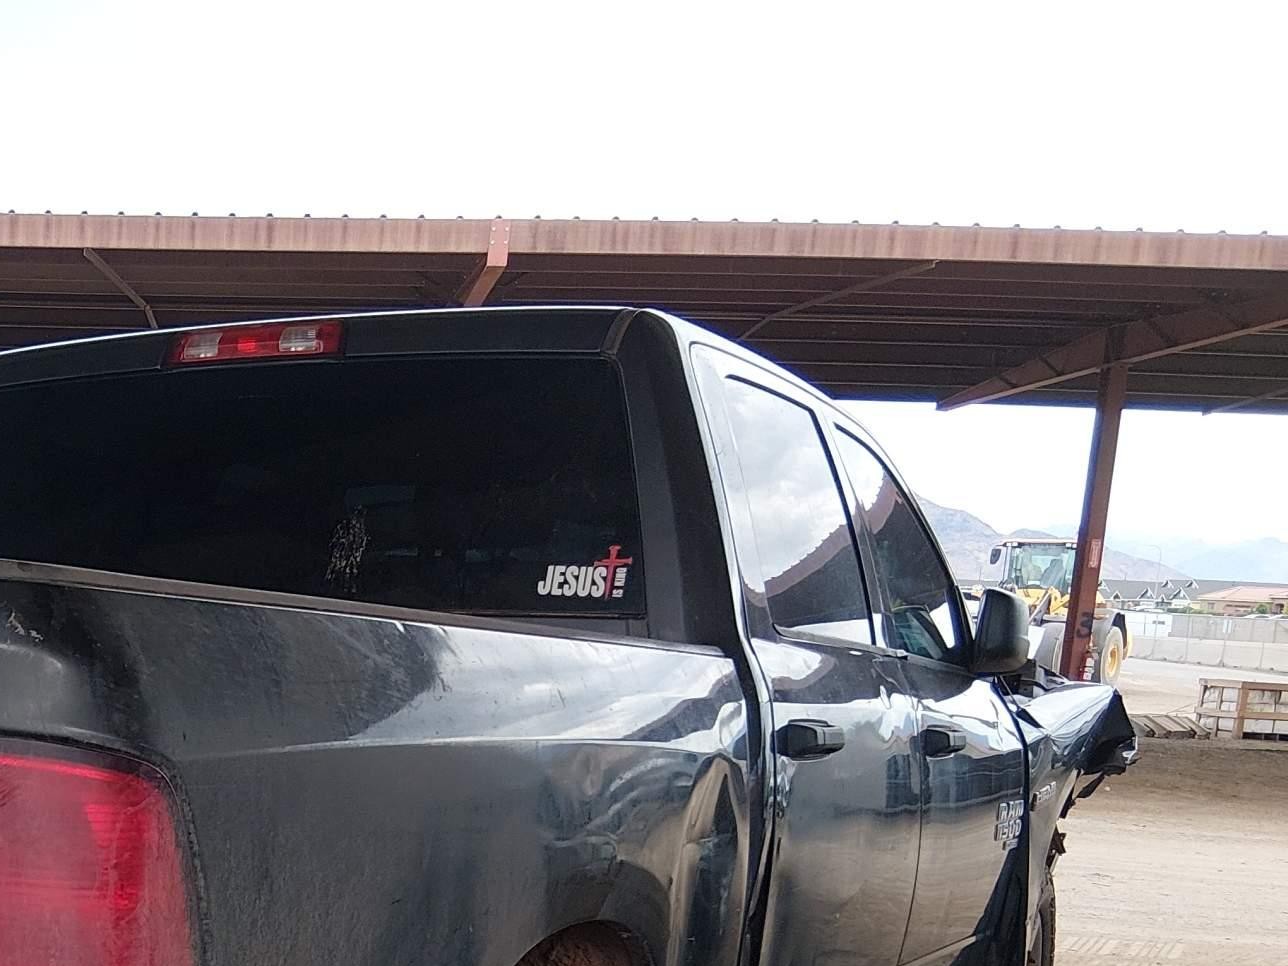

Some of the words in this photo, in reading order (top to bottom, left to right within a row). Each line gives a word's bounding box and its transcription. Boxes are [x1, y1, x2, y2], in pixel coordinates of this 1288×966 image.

[537, 565, 607, 598] JESUS
[614, 567, 628, 587] KING
[612, 589, 624, 598] IS
[998, 800, 1024, 821] RAM
[994, 819, 1022, 841] 1500
